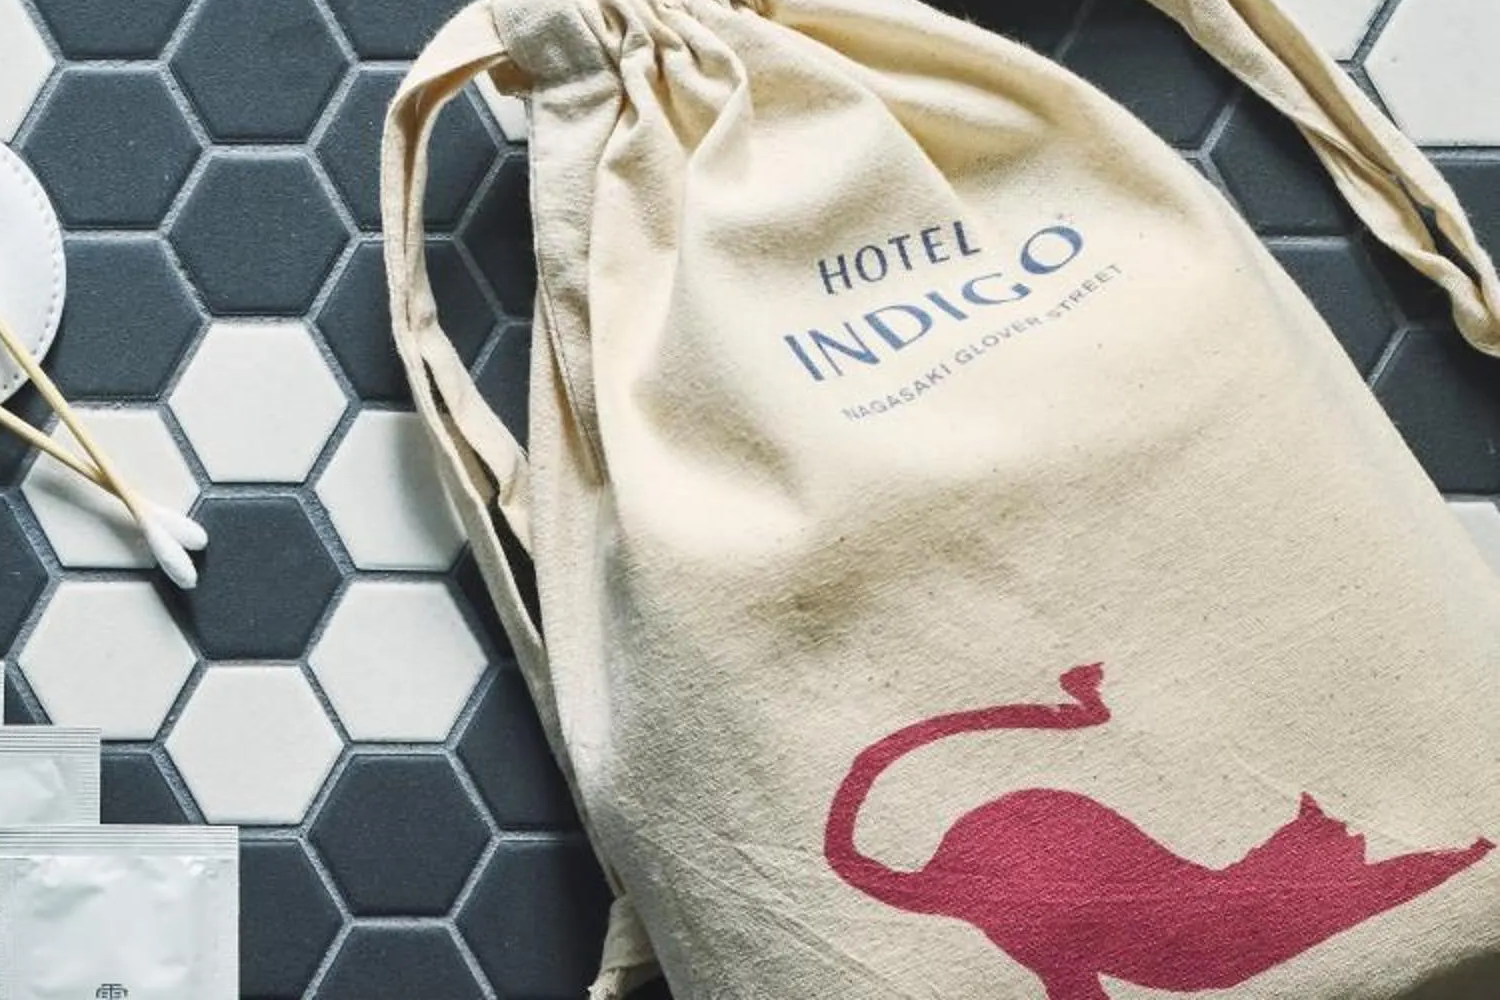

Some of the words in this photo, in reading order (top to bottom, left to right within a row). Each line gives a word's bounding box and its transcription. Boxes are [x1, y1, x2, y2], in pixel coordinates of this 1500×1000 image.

[783, 225, 1084, 382] INDIGO
[817, 220, 982, 295] HOTEL
[841, 362, 952, 421] NAGASAKI
[954, 315, 1043, 366] GLOVER
[1046, 263, 1123, 322] STREET
